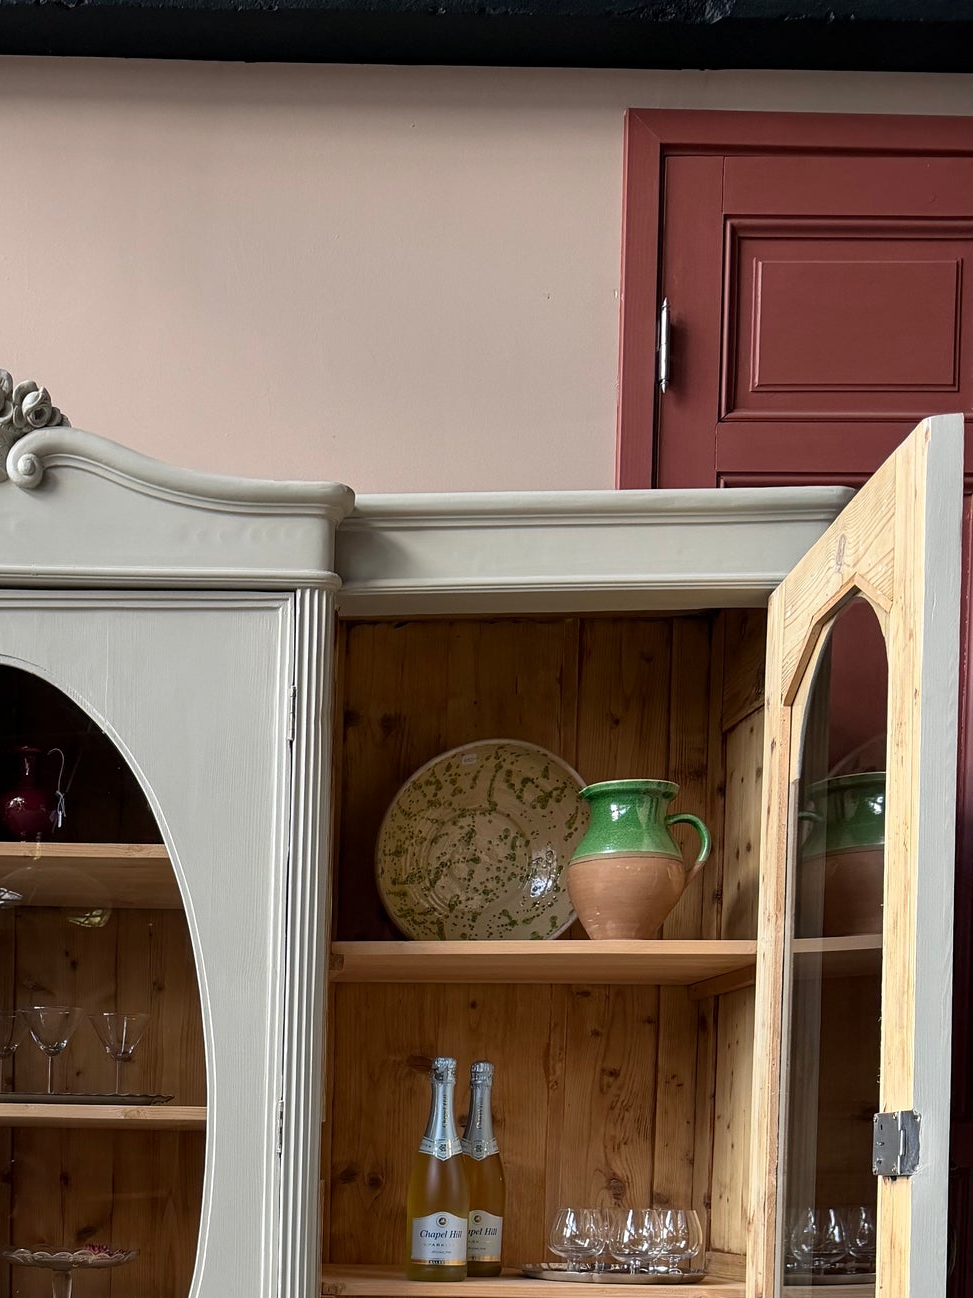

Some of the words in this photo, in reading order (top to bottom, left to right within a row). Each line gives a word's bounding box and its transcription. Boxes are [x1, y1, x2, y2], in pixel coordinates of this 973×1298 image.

[420, 1229, 448, 1240] Chapel
[449, 1230, 463, 1239] Hill
[484, 1227, 498, 1236] Hill
